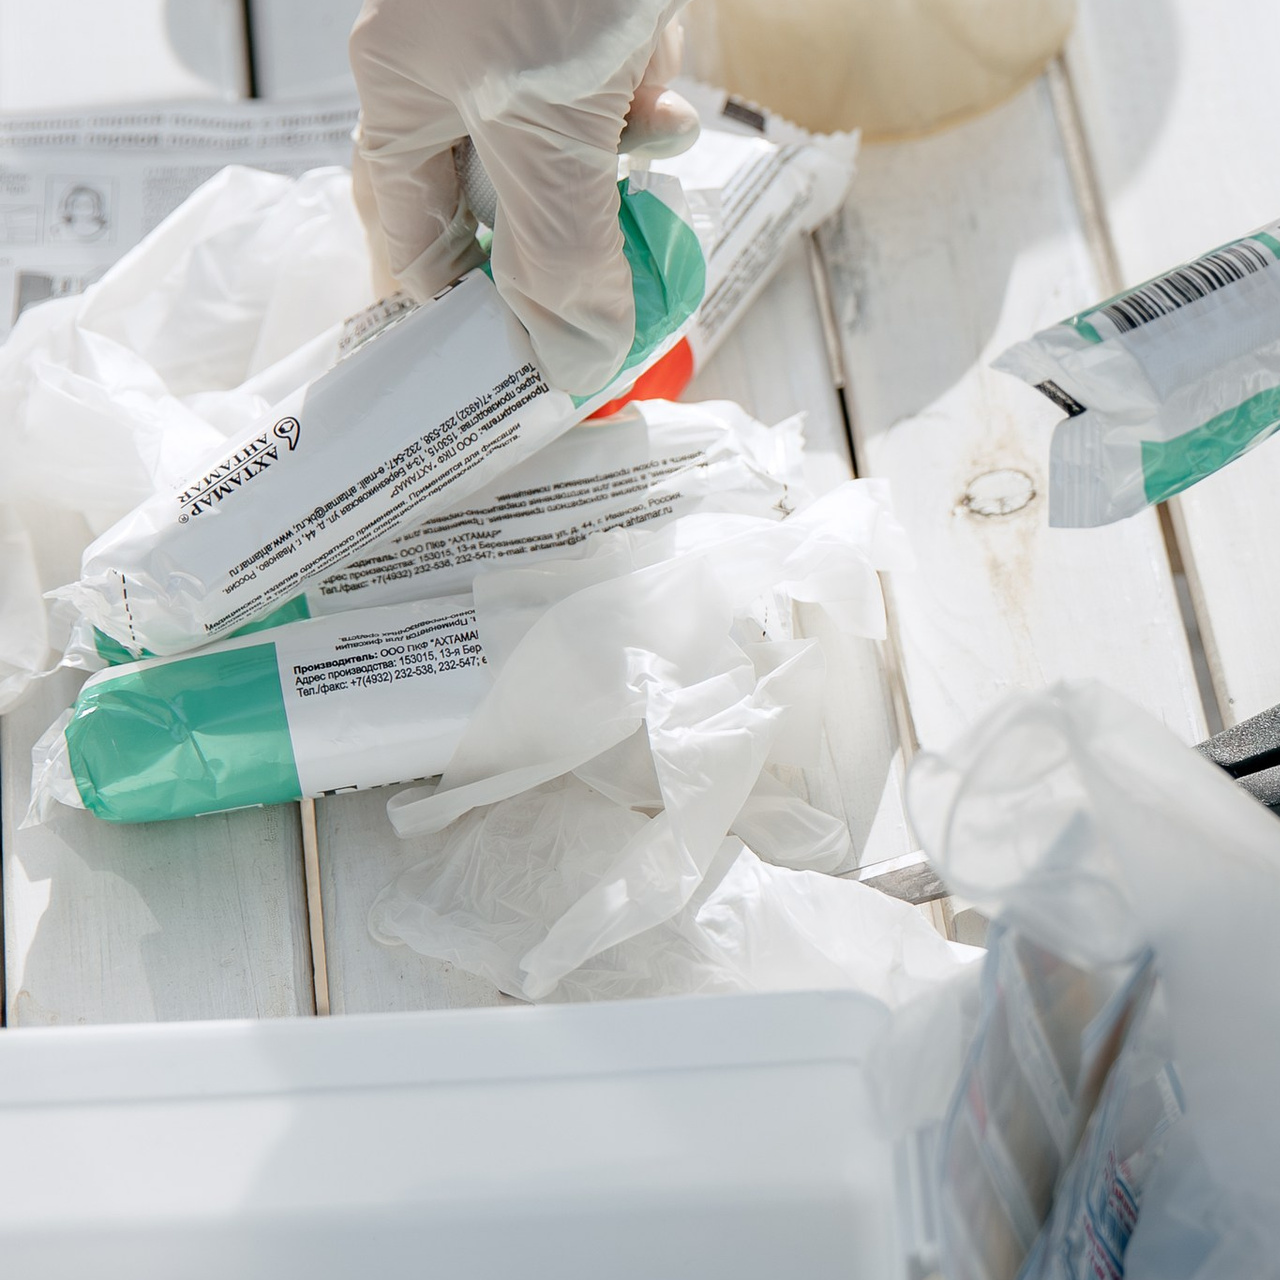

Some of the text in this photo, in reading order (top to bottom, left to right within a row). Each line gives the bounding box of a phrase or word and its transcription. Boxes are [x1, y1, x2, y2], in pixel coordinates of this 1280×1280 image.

[489, 359, 536, 397] Тел./факс:
[513, 370, 543, 396] Адрес
[453, 388, 495, 423] +7(4932)
[455, 388, 517, 435] производства:
[475, 380, 550, 437] Производитель:
[418, 414, 458, 447] 232-538,
[422, 429, 459, 459] 153015,
[454, 430, 480, 452] ООО
[174, 431, 272, 507] AHTAMAR
[382, 439, 423, 472] 232-547;
[403, 452, 426, 472] 13-я
[434, 446, 457, 465] ПКФ
[186, 443, 284, 521] АХТАМАР
[337, 465, 407, 517] Березниковская
[353, 497, 408, 537] применения.
[479, 421, 522, 453] фиксации
[355, 464, 387, 491] e-mail:
[290, 484, 359, 535] ahtamar@bk.ru;
[313, 519, 327, 532] д.
[323, 510, 340, 525] ул.
[294, 537, 303, 547] г.
[299, 526, 318, 543] 44,
[398, 543, 425, 558] ООО
[227, 528, 296, 580] www.ahtamar.ru
[253, 540, 297, 575] Иваново,
[220, 568, 258, 598] Россия.
[292, 651, 378, 676] Производитель:
[379, 644, 405, 658] ООО
[406, 640, 429, 652] ПКФ
[334, 635, 383, 654] фиксации
[293, 671, 327, 687] Адрес
[326, 658, 397, 680] производства:
[398, 649, 438, 667] 153015,
[439, 645, 461, 659] 13-я
[295, 678, 349, 699] Тел./факс:
[349, 670, 394, 690] +7(4932)
[393, 662, 437, 681] 232-538,
[437, 654, 480, 673] 232-547;
